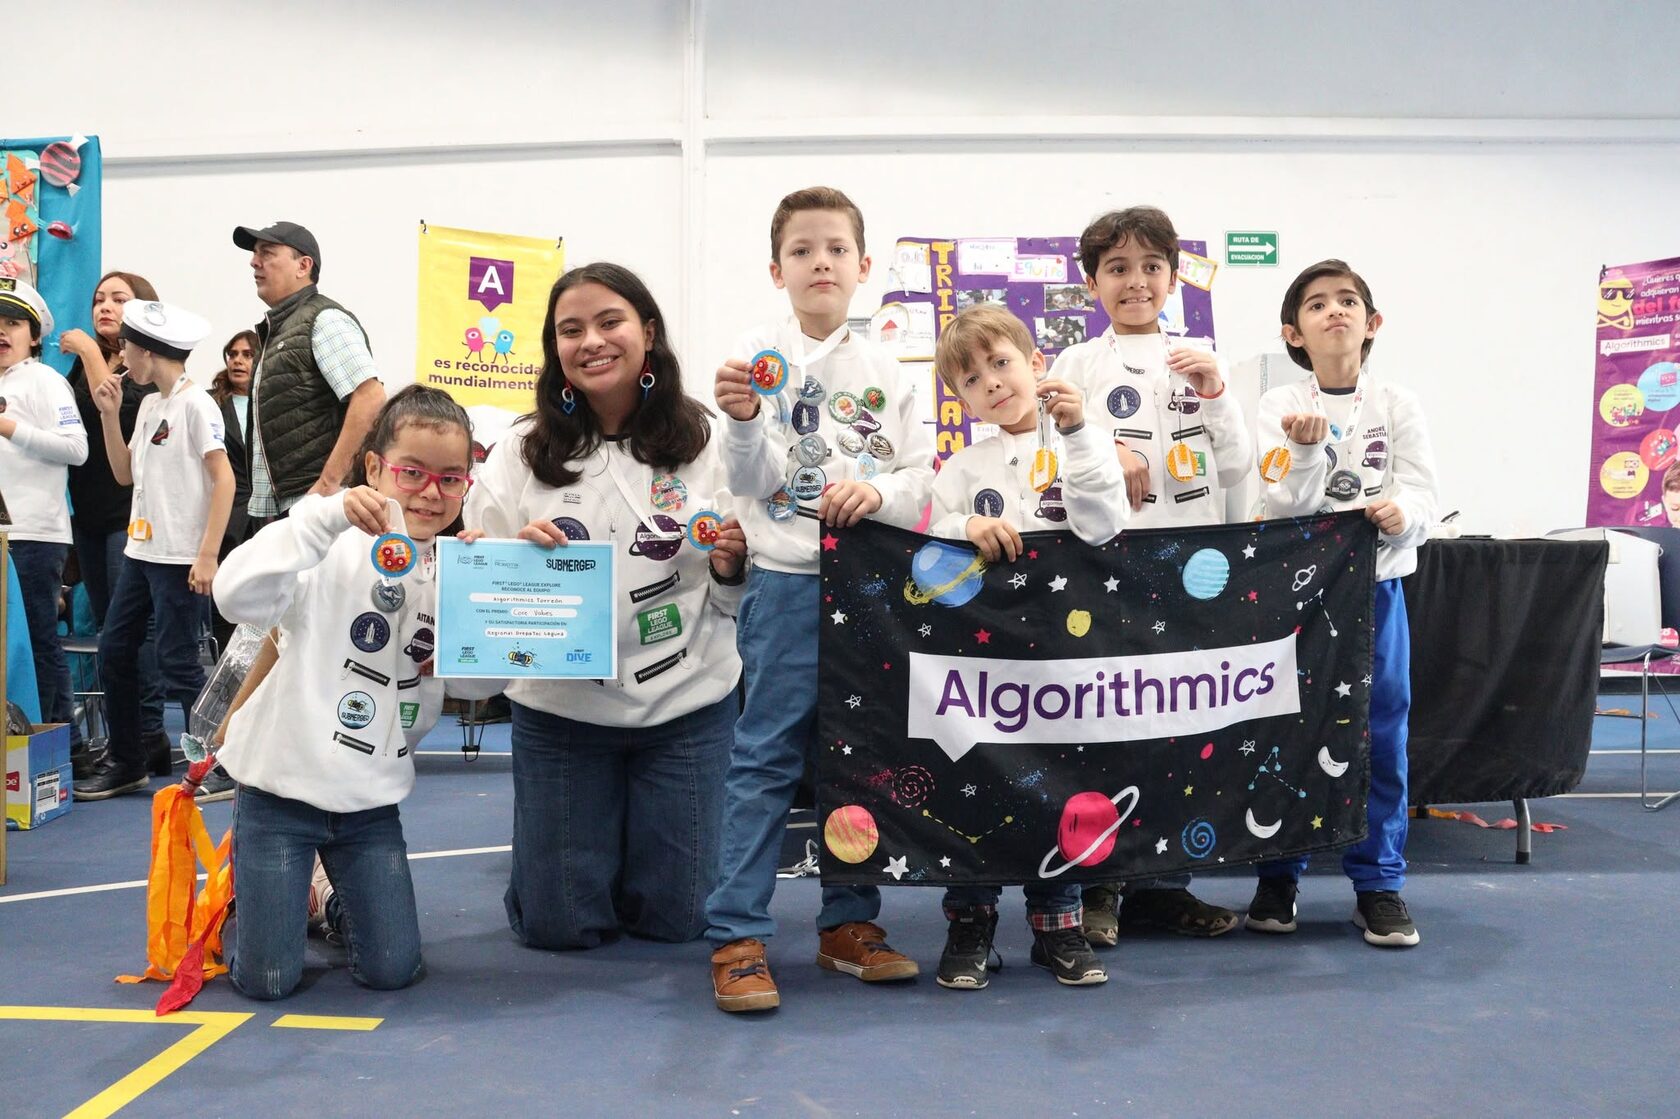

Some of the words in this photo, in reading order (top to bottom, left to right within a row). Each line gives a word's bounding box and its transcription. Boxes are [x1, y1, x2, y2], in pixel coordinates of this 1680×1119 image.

[477, 265, 505, 295] A
[1640, 286, 1680, 299] adquieran
[1633, 296, 1663, 315] del
[1636, 313, 1673, 326] mientras
[1605, 337, 1666, 352] Algorithmics
[434, 359, 451, 369] es
[456, 361, 542, 375] reconocida
[546, 558, 597, 572] SUBMERGED
[647, 608, 668, 621] FIRST
[650, 616, 668, 627] LEGO
[647, 620, 674, 634] LEAGUE
[566, 653, 592, 662] DIVE
[935, 661, 1276, 734] Algorithmics
